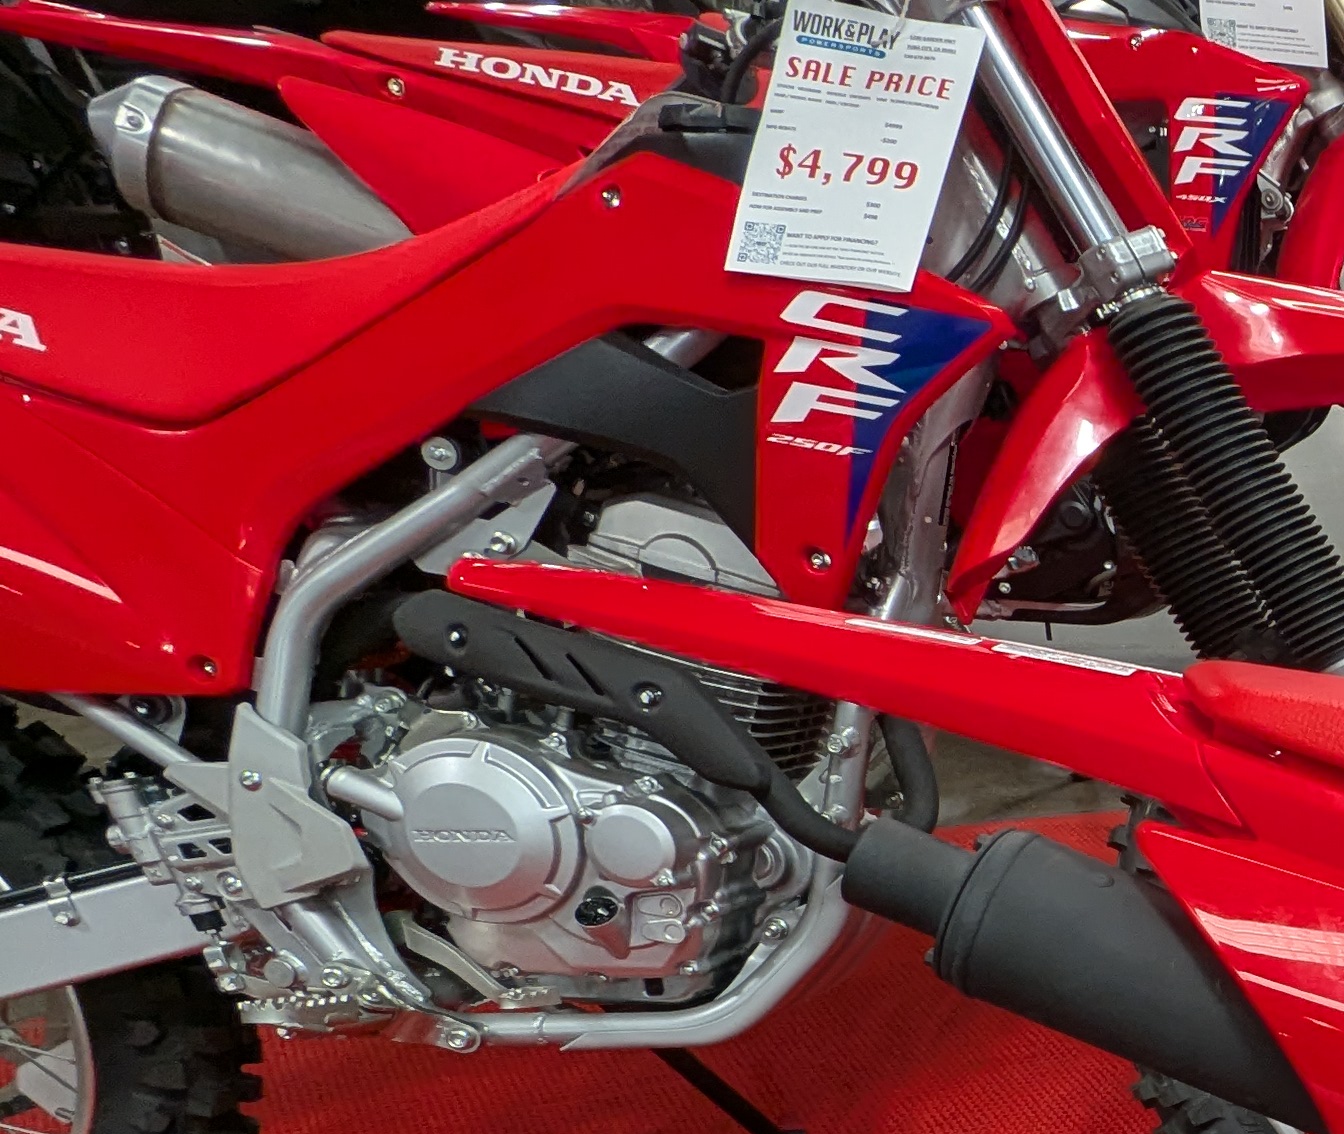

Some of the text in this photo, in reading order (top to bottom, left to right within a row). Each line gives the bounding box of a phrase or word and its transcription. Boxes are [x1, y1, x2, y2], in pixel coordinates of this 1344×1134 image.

[800, 36, 881, 57] POWERSPORTS
[434, 47, 641, 107] HONDA
[785, 56, 857, 88] SALE
[865, 70, 955, 101] PRICE
[1173, 96, 1253, 185] CRF
[775, 143, 919, 189] $4,799
[770, 290, 909, 423] CRF
[766, 433, 874, 456] 250F
[411, 829, 517, 843] HONDA
